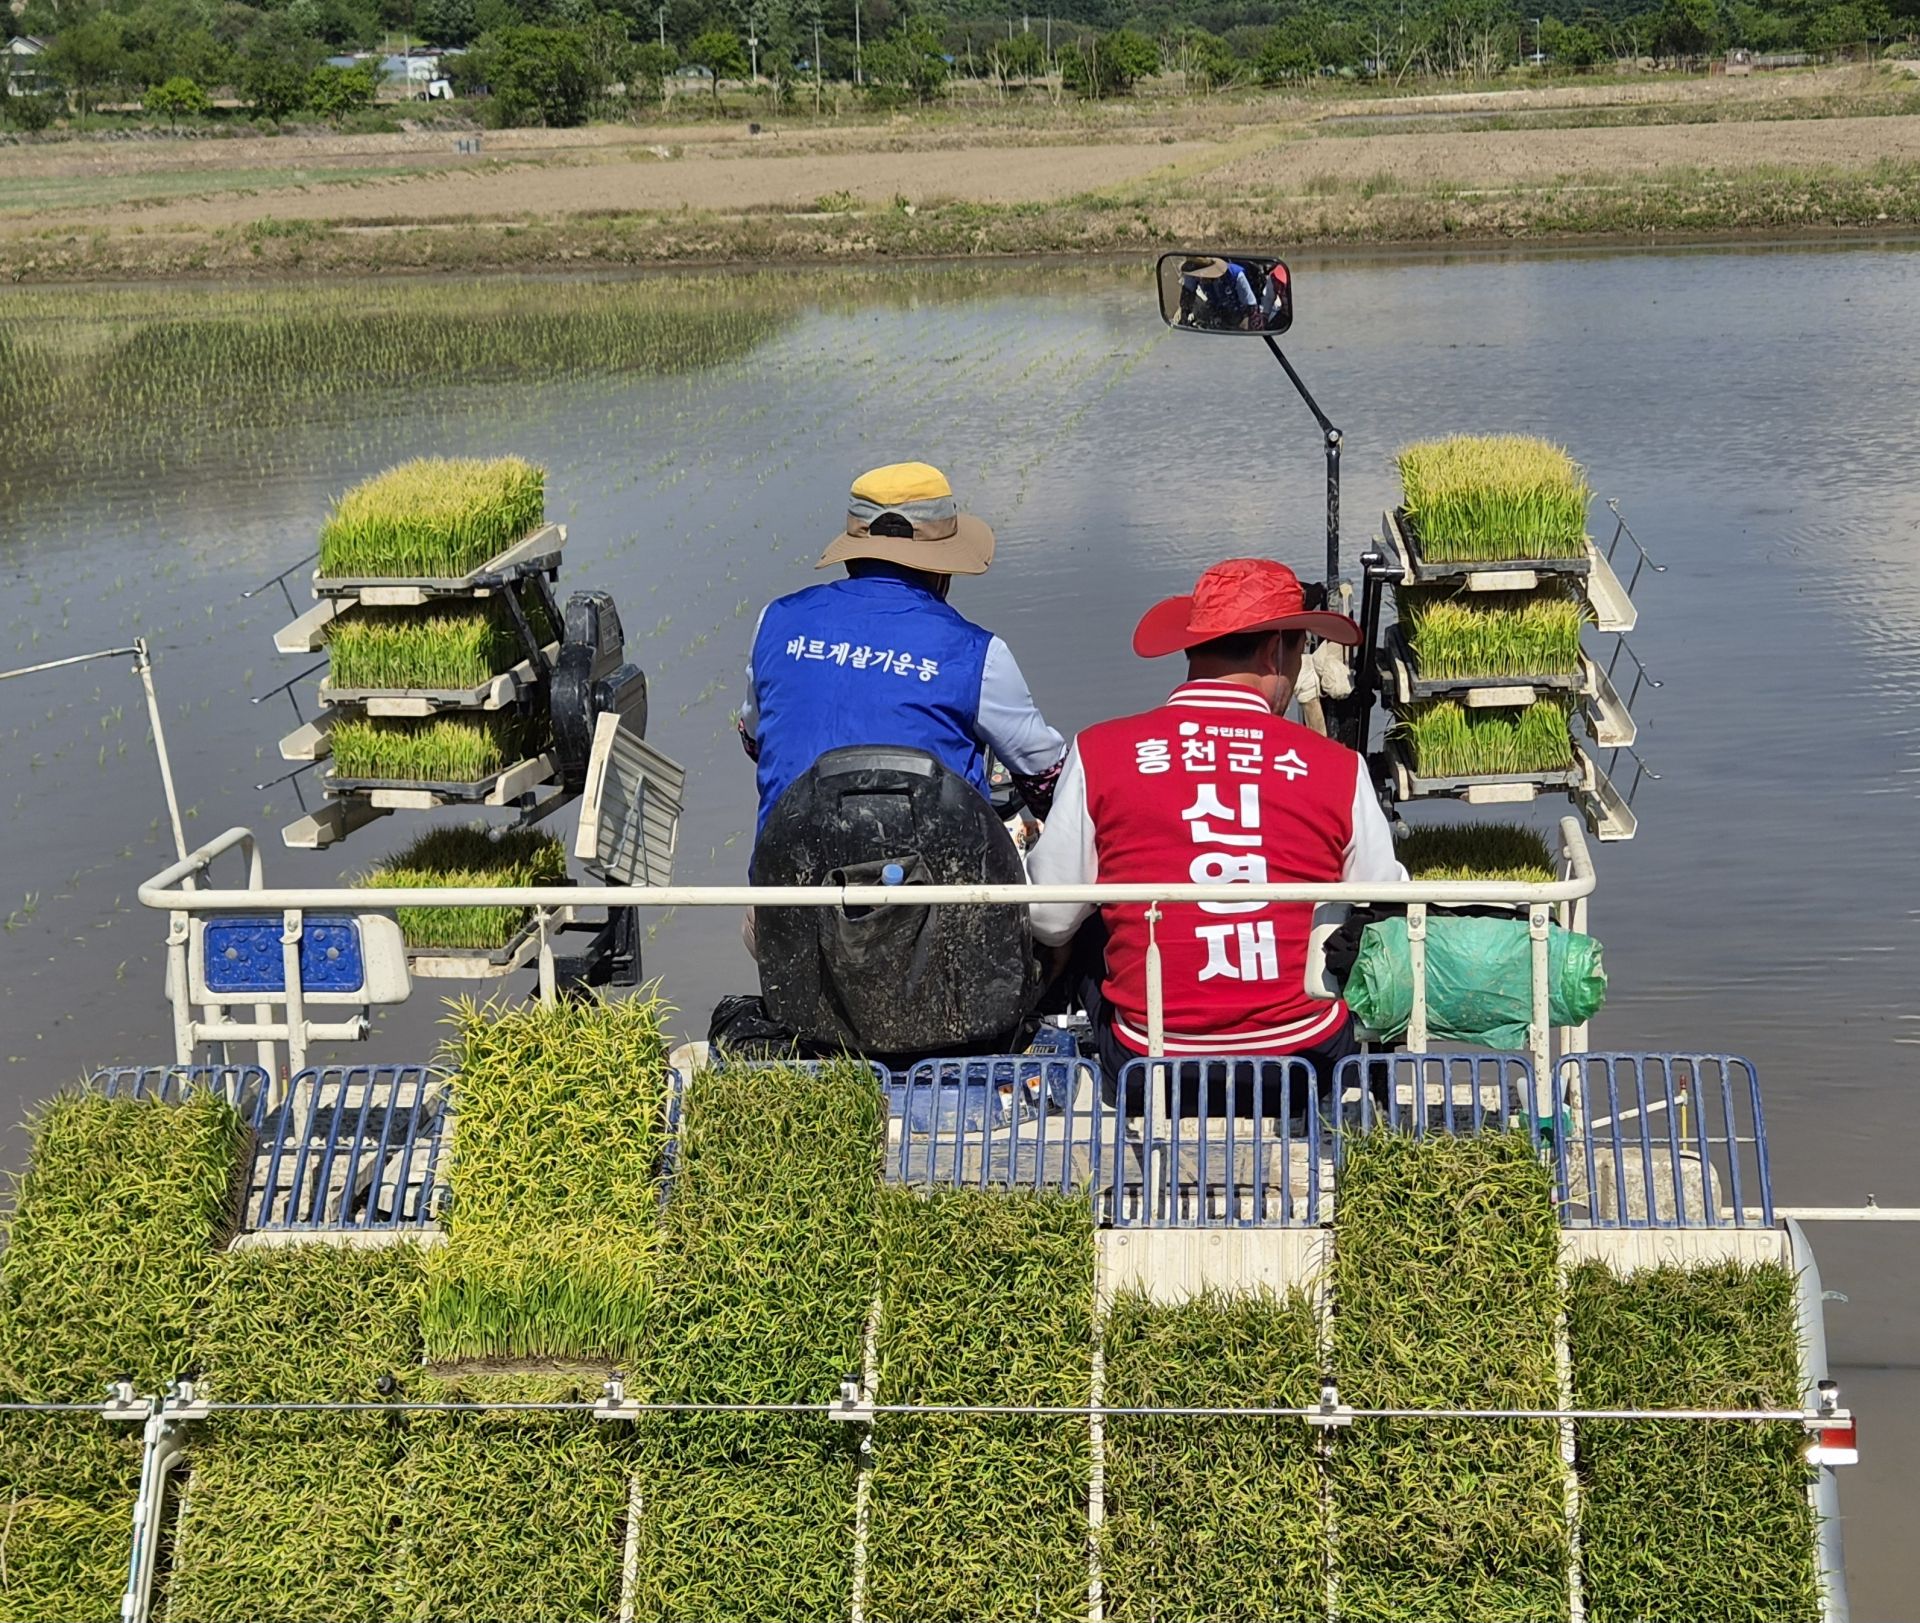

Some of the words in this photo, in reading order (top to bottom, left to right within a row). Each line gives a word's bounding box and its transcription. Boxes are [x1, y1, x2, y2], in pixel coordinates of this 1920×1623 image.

[786, 635, 940, 682] 바르게살기운동
[1204, 725, 1264, 740] 국민의힘
[1135, 738, 1308, 781] 홍천군수
[1181, 783, 1280, 982] 신영재
